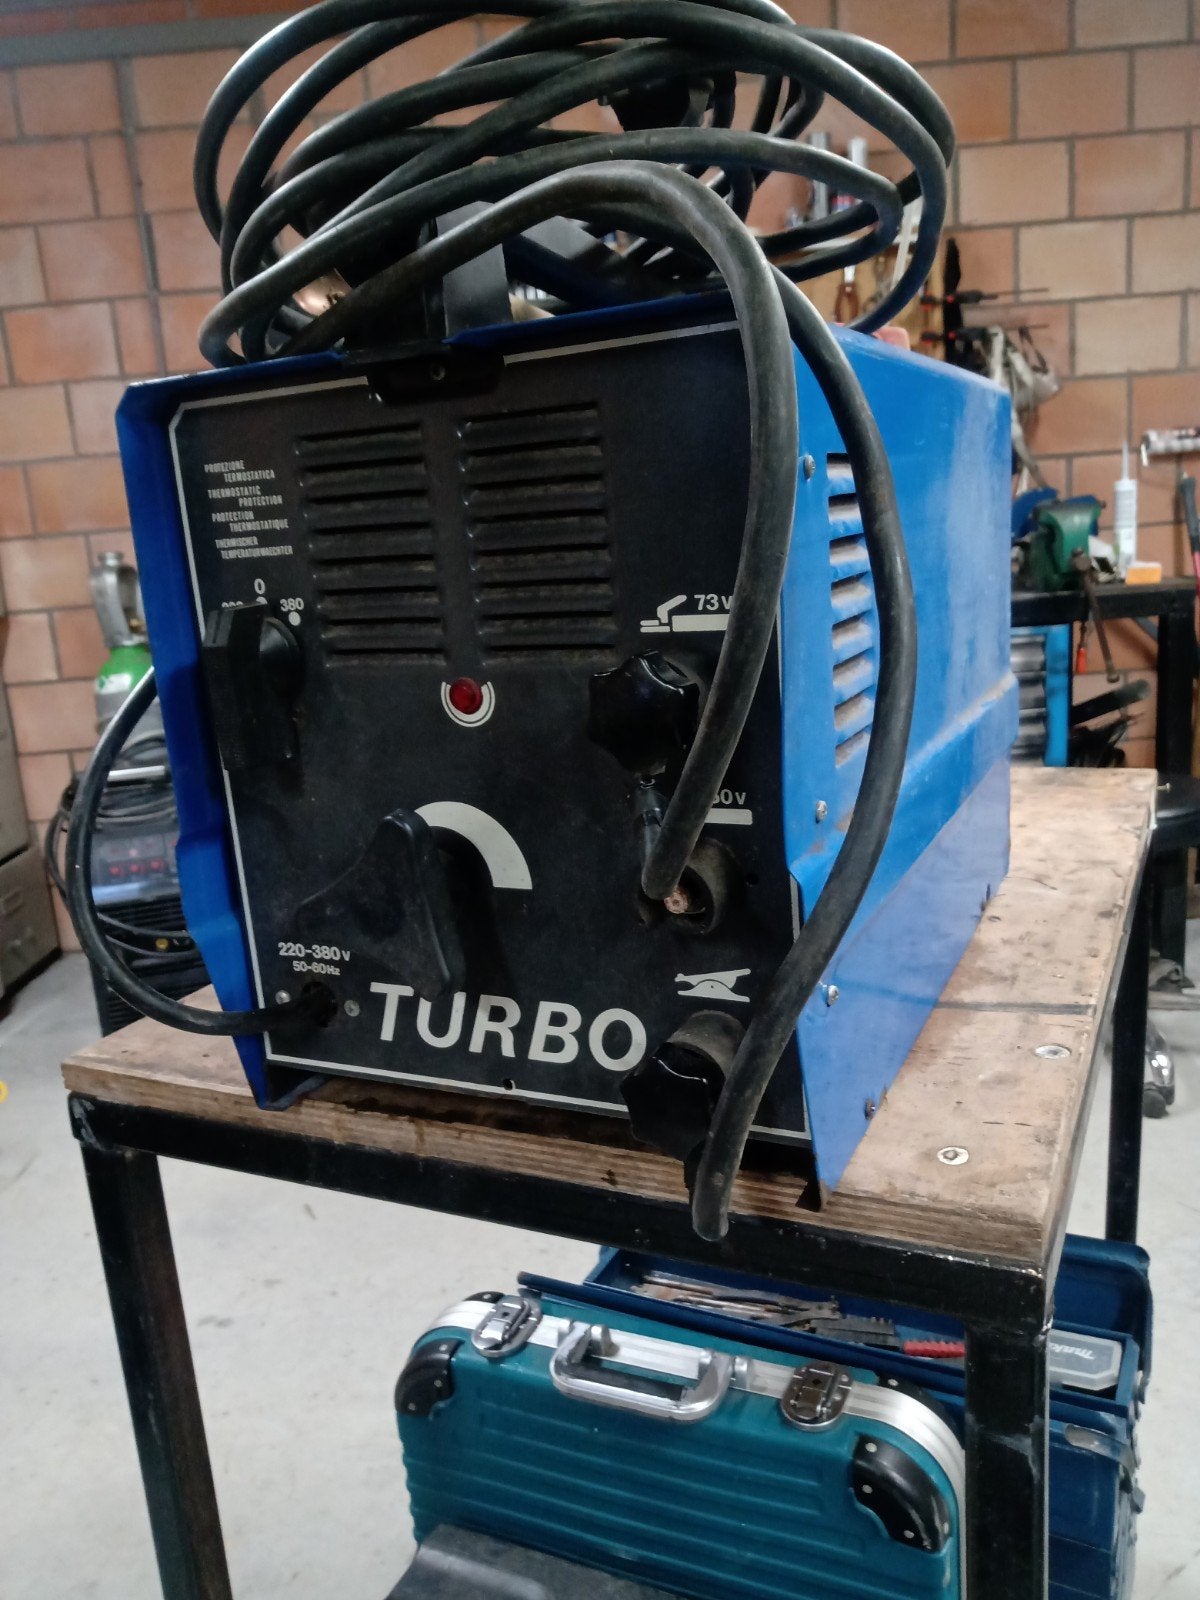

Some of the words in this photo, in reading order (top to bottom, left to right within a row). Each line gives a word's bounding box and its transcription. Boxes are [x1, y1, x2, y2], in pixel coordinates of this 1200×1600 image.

[224, 469, 275, 482] TERMOSTATICA
[207, 485, 261, 499] THERMOSTATIC
[238, 495, 283, 507] PROTECTION
[211, 511, 254, 523] PROTECTION
[229, 518, 289, 532] THERMOSTATIQUE
[254, 578, 266, 594] 0
[280, 597, 304, 612] 380
[370, 981, 647, 1072] TURBO
